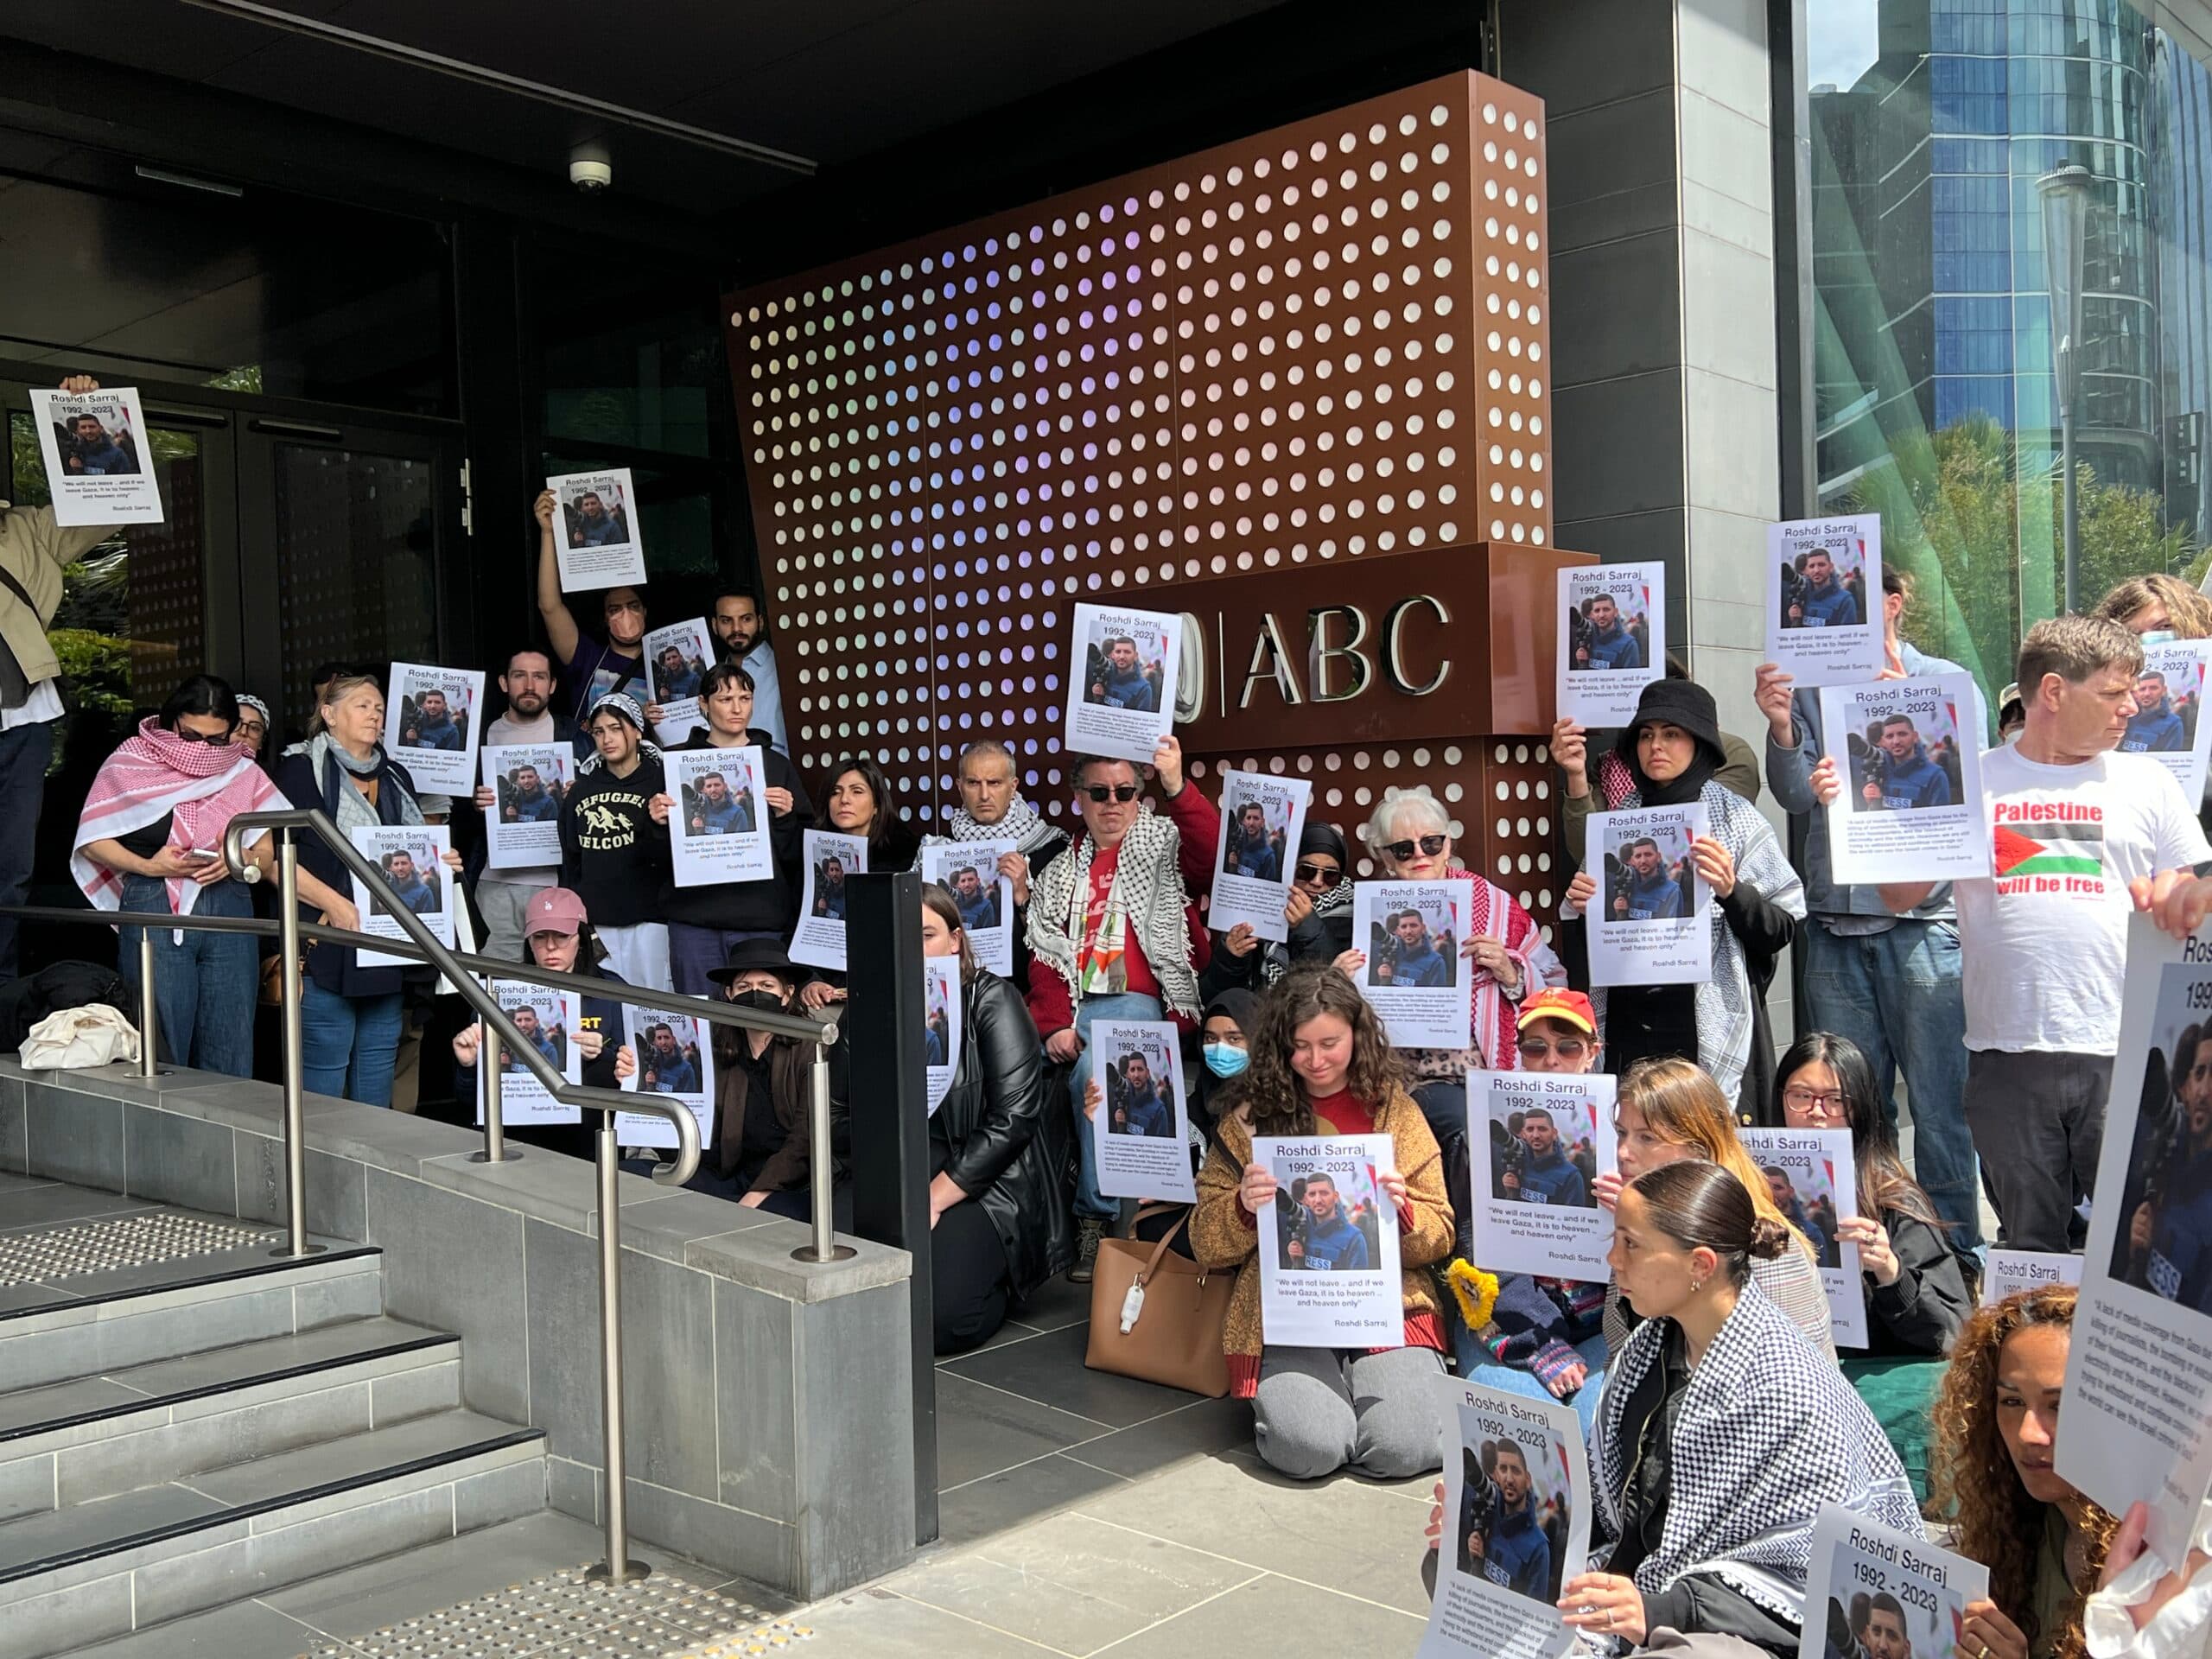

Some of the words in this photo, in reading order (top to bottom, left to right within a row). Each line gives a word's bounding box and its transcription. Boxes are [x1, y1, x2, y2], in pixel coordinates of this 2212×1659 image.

[51, 395, 86, 404] Roshdi
[88, 394, 119, 403] Sarraj
[1785, 527, 1821, 537] Roshdi
[1825, 524, 1858, 535] Sarraj
[1794, 541, 1815, 550] 1992
[1825, 538, 1847, 548] 2023
[1573, 572, 1605, 582] Roshdi
[1609, 570, 1642, 581] Sarraj
[1610, 584, 1632, 593] 2023
[1100, 613, 1131, 625] Roshdi
[1135, 617, 1160, 629] Sarraj
[1104, 626, 1124, 636] 1992
[1134, 630, 1154, 639] 2023
[1239, 594, 1452, 709] ABC
[2164, 648, 2198, 658] Sarraj
[2164, 662, 2190, 671] 2023
[408, 669, 440, 680] Roshdi
[442, 672, 468, 684] Sarraj
[416, 681, 434, 690] 1992
[442, 683, 460, 692] 2023
[1856, 690, 1899, 702] Roshdi
[1904, 685, 1941, 698] Sarraj
[1864, 706, 1893, 717] 1992
[1906, 702, 1936, 714] 2023
[683, 754, 715, 763] Roshdi
[717, 752, 745, 761] Sarraj
[691, 766, 710, 774] 1992
[1236, 779, 1261, 790] Roshdi
[1262, 783, 1288, 795] Sarraj
[1239, 792, 1255, 802] 1992
[1262, 796, 1281, 805] 2023
[1994, 802, 2103, 822] Palestine
[1608, 816, 1647, 828] Roshdi
[1650, 811, 1685, 824] Sarraj
[406, 832, 429, 842] Sarraj
[1618, 830, 1641, 839] 1992
[1651, 827, 1676, 836] 2023
[973, 847, 995, 855] Sarraj
[975, 857, 992, 866] 2023
[1381, 888, 1414, 897] Roshdi
[1418, 887, 1447, 897] Sarraj
[1997, 878, 2031, 895] will
[2036, 876, 2060, 892] be
[2065, 876, 2105, 893] free
[1386, 901, 1408, 910] 1992
[1418, 900, 1441, 909] 2023
[2183, 935, 2212, 963] Ros
[2186, 982, 2212, 1009] 199
[1113, 1028, 1139, 1039] Roshdi
[1141, 1029, 1162, 1040] Sarraj
[1118, 1042, 1135, 1052] 1992
[1142, 1044, 1160, 1052] 2023
[1493, 1079, 1541, 1092] Roshdi
[1545, 1081, 1586, 1096] Sarraj
[1505, 1096, 1534, 1108] 1992
[1547, 1099, 1576, 1110] 2023
[1277, 1144, 1320, 1156] Roshdi
[1324, 1143, 1365, 1156] Sarraj
[1740, 1137, 1773, 1149] shdi
[1778, 1137, 1821, 1152] Sarraj
[1752, 1155, 1767, 1166] 92
[1780, 1156, 1811, 1166] 2023
[1288, 1163, 1313, 1173] 1992
[1327, 1162, 1355, 1172] 2023
[1998, 1262, 2027, 1277] Roshdi
[2030, 1263, 2060, 1283] Sarraj
[1465, 1392, 1507, 1415] Roshdi
[1512, 1403, 1549, 1429] Sarraj
[1478, 1417, 1505, 1437] 1992
[1517, 1428, 1547, 1450] 2023
[1849, 1528, 1898, 1564] Roshdi
[1901, 1549, 1948, 1589] Sarraj
[1853, 1562, 1885, 1592] 1992
[1901, 1581, 1937, 1613] 2023
